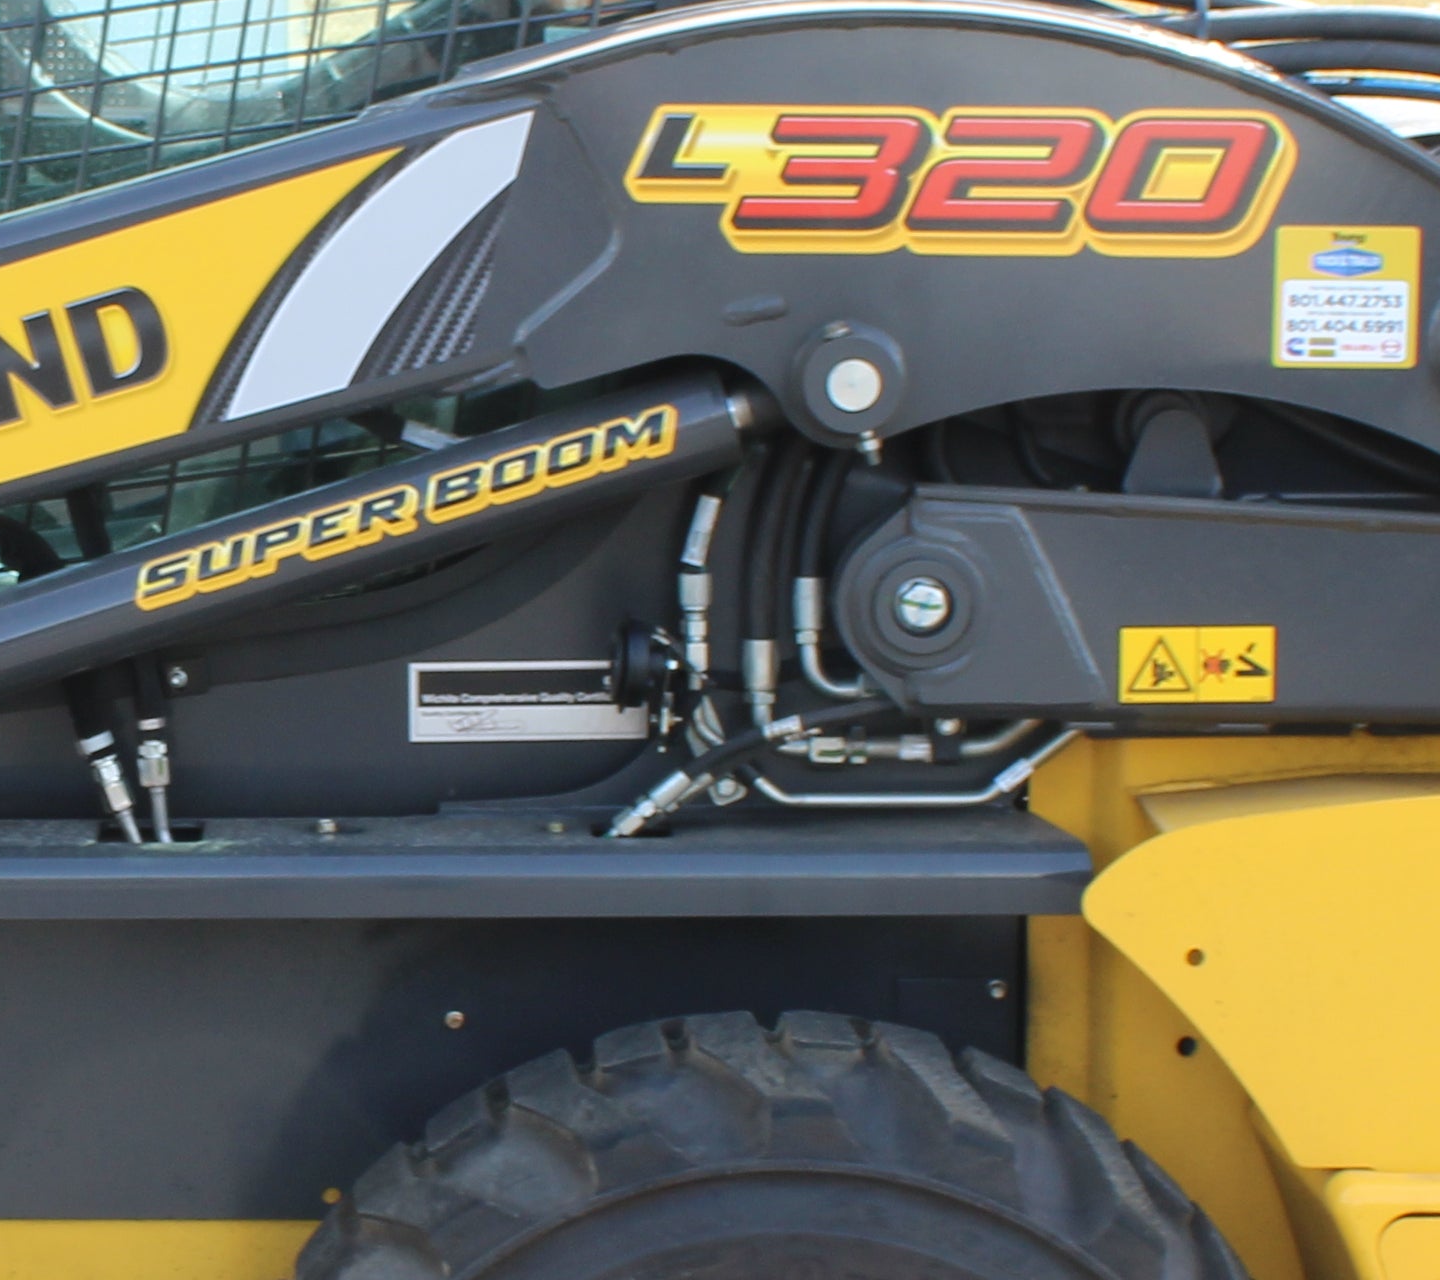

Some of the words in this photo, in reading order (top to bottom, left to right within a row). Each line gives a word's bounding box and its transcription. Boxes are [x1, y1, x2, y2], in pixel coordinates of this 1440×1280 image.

[628, 106, 1296, 250] L320
[136, 485, 418, 610] SUPER
[425, 404, 678, 523] BOOM
